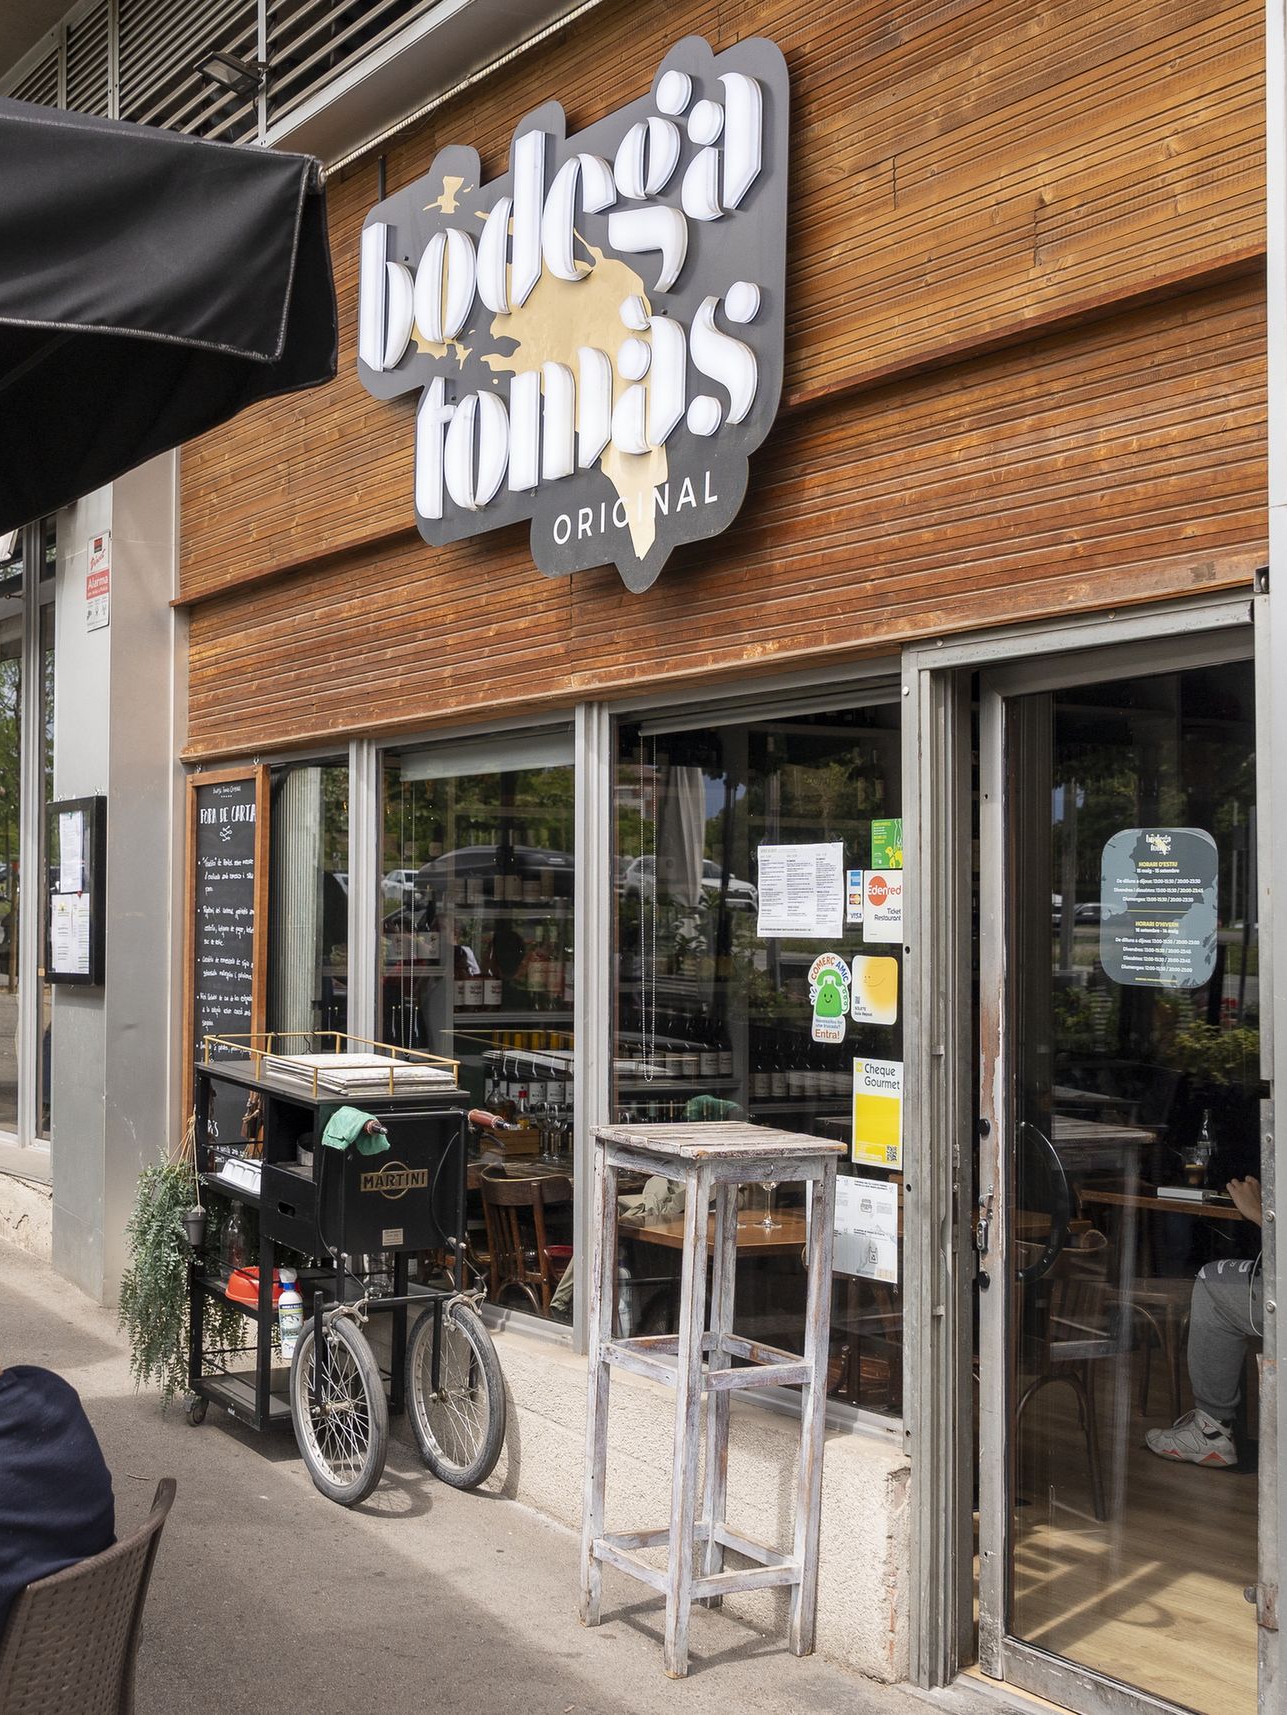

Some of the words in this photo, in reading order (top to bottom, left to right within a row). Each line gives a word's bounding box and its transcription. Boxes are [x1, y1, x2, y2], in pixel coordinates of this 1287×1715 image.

[359, 69, 762, 373] bodega
[868, 885, 901, 896] Edenred
[835, 961, 849, 982] AMIC
[815, 1029, 840, 1039] Entra!
[864, 1063, 896, 1077] Cheque
[864, 1076, 900, 1090] Gourmet
[363, 1172, 425, 1189] MARTINI
